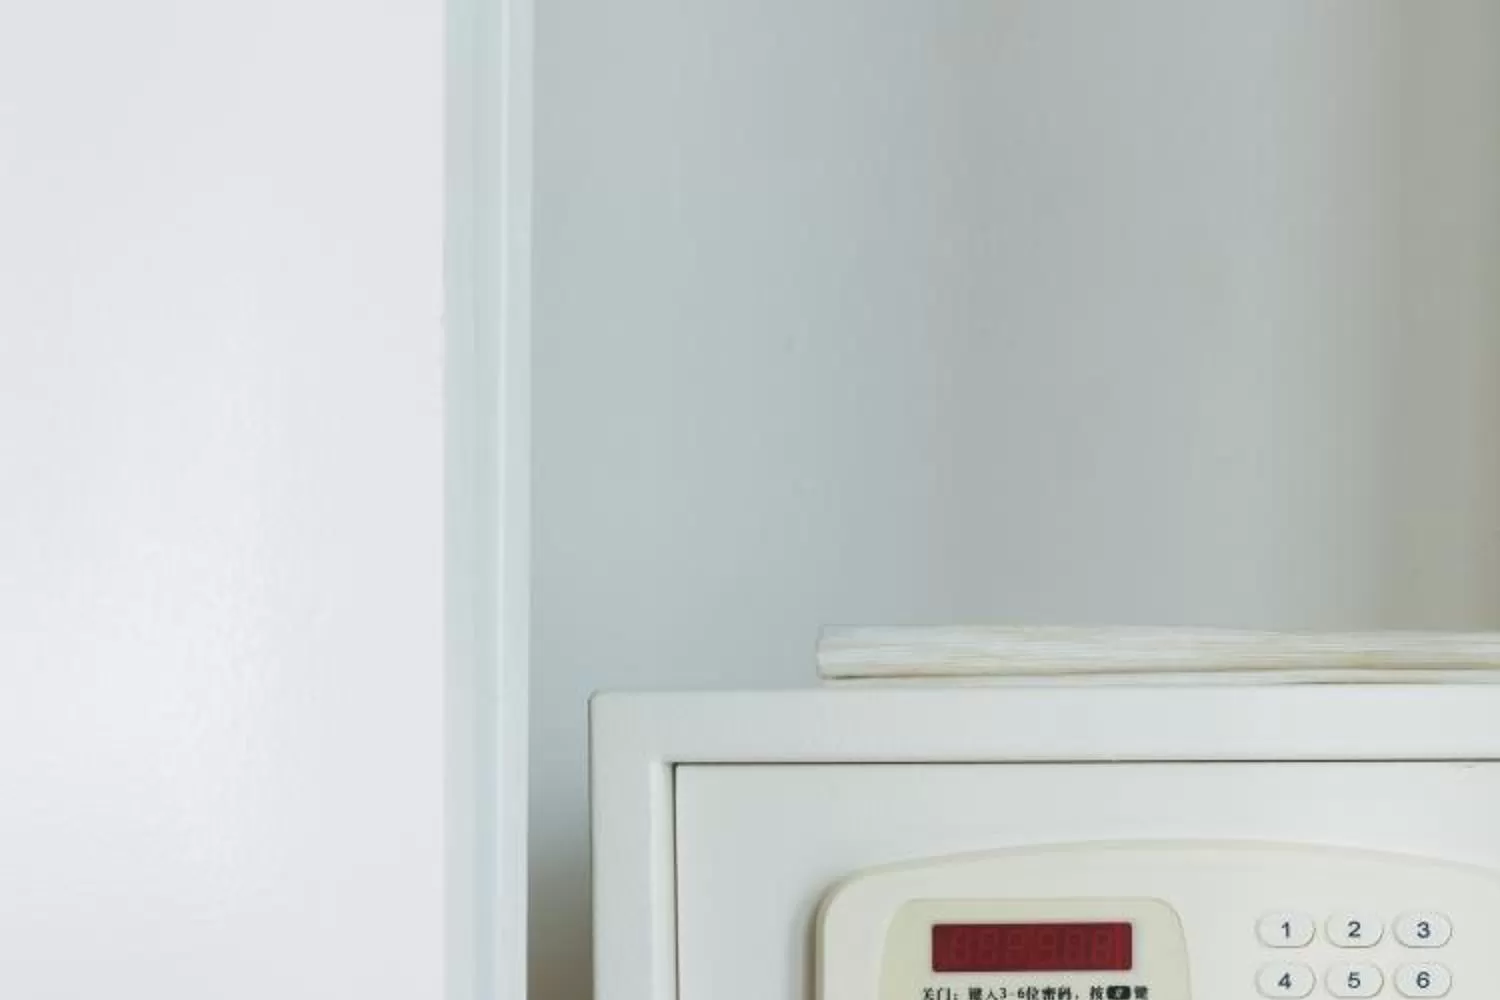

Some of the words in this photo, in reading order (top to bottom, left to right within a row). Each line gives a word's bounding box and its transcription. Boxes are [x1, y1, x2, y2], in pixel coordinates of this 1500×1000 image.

[1281, 922, 1291, 938] 1
[1347, 921, 1361, 938] 2
[1416, 921, 1432, 939] 3
[1277, 973, 1292, 989] 4
[1347, 972, 1361, 988] 5
[1415, 971, 1431, 989] 6
